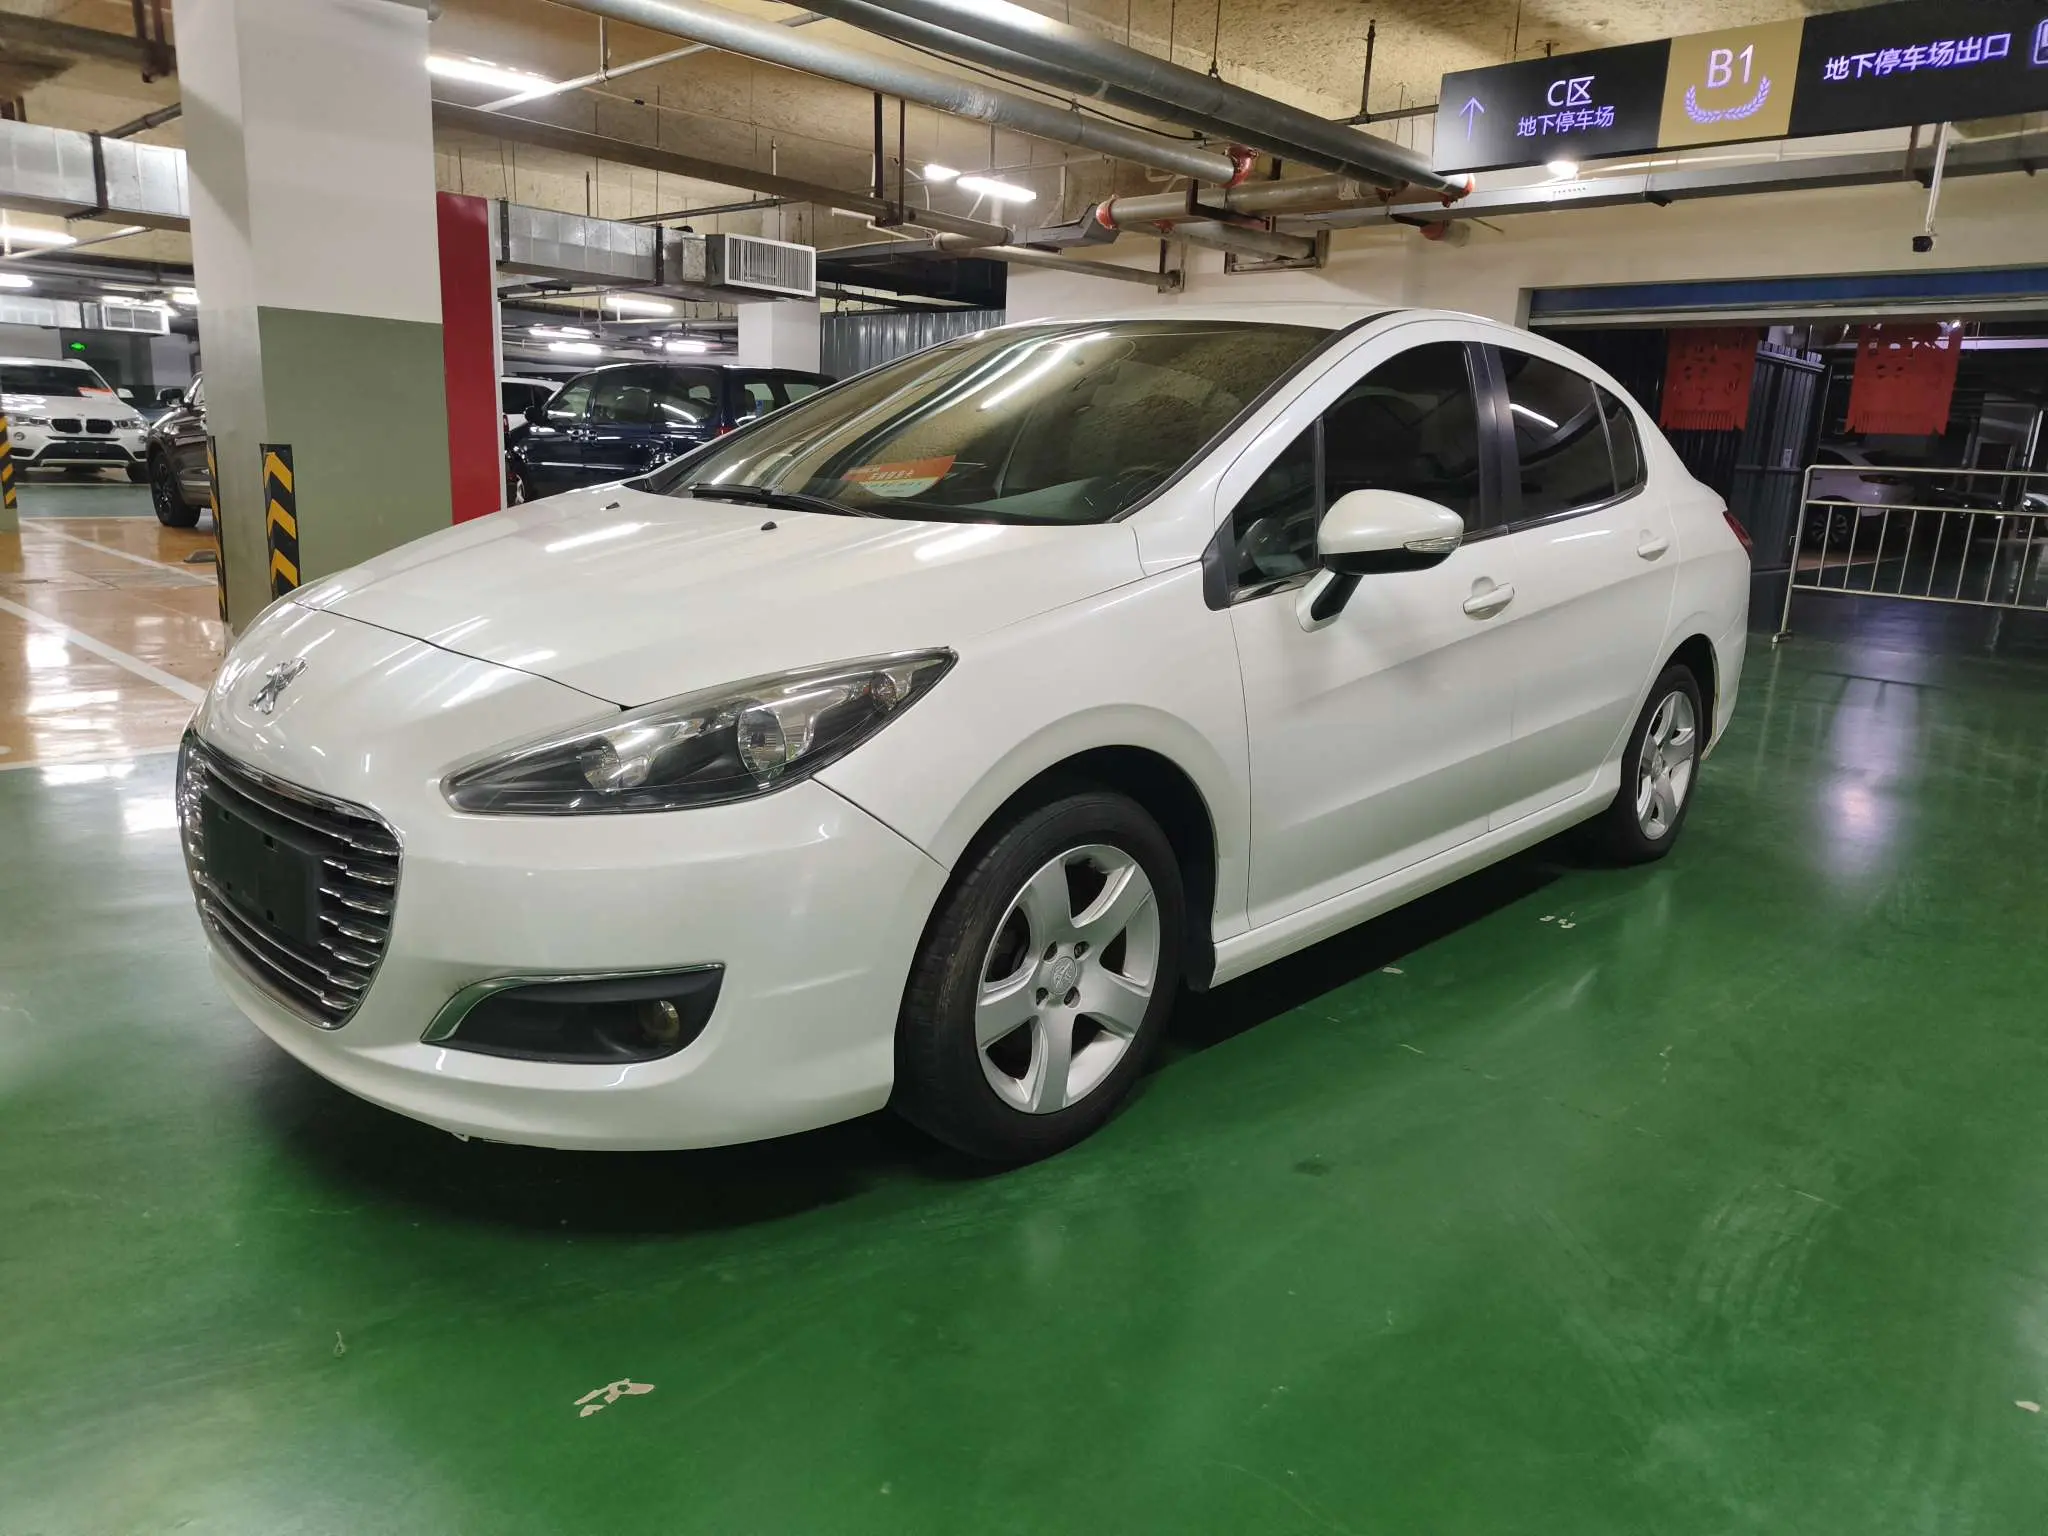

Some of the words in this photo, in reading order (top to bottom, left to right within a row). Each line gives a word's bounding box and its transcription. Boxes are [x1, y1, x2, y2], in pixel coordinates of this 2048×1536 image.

[1707, 43, 1755, 89] B1
[1824, 33, 2011, 81] 地下停车场出口
[1547, 75, 1595, 106] C区
[1517, 106, 1615, 137] 地下停车场
